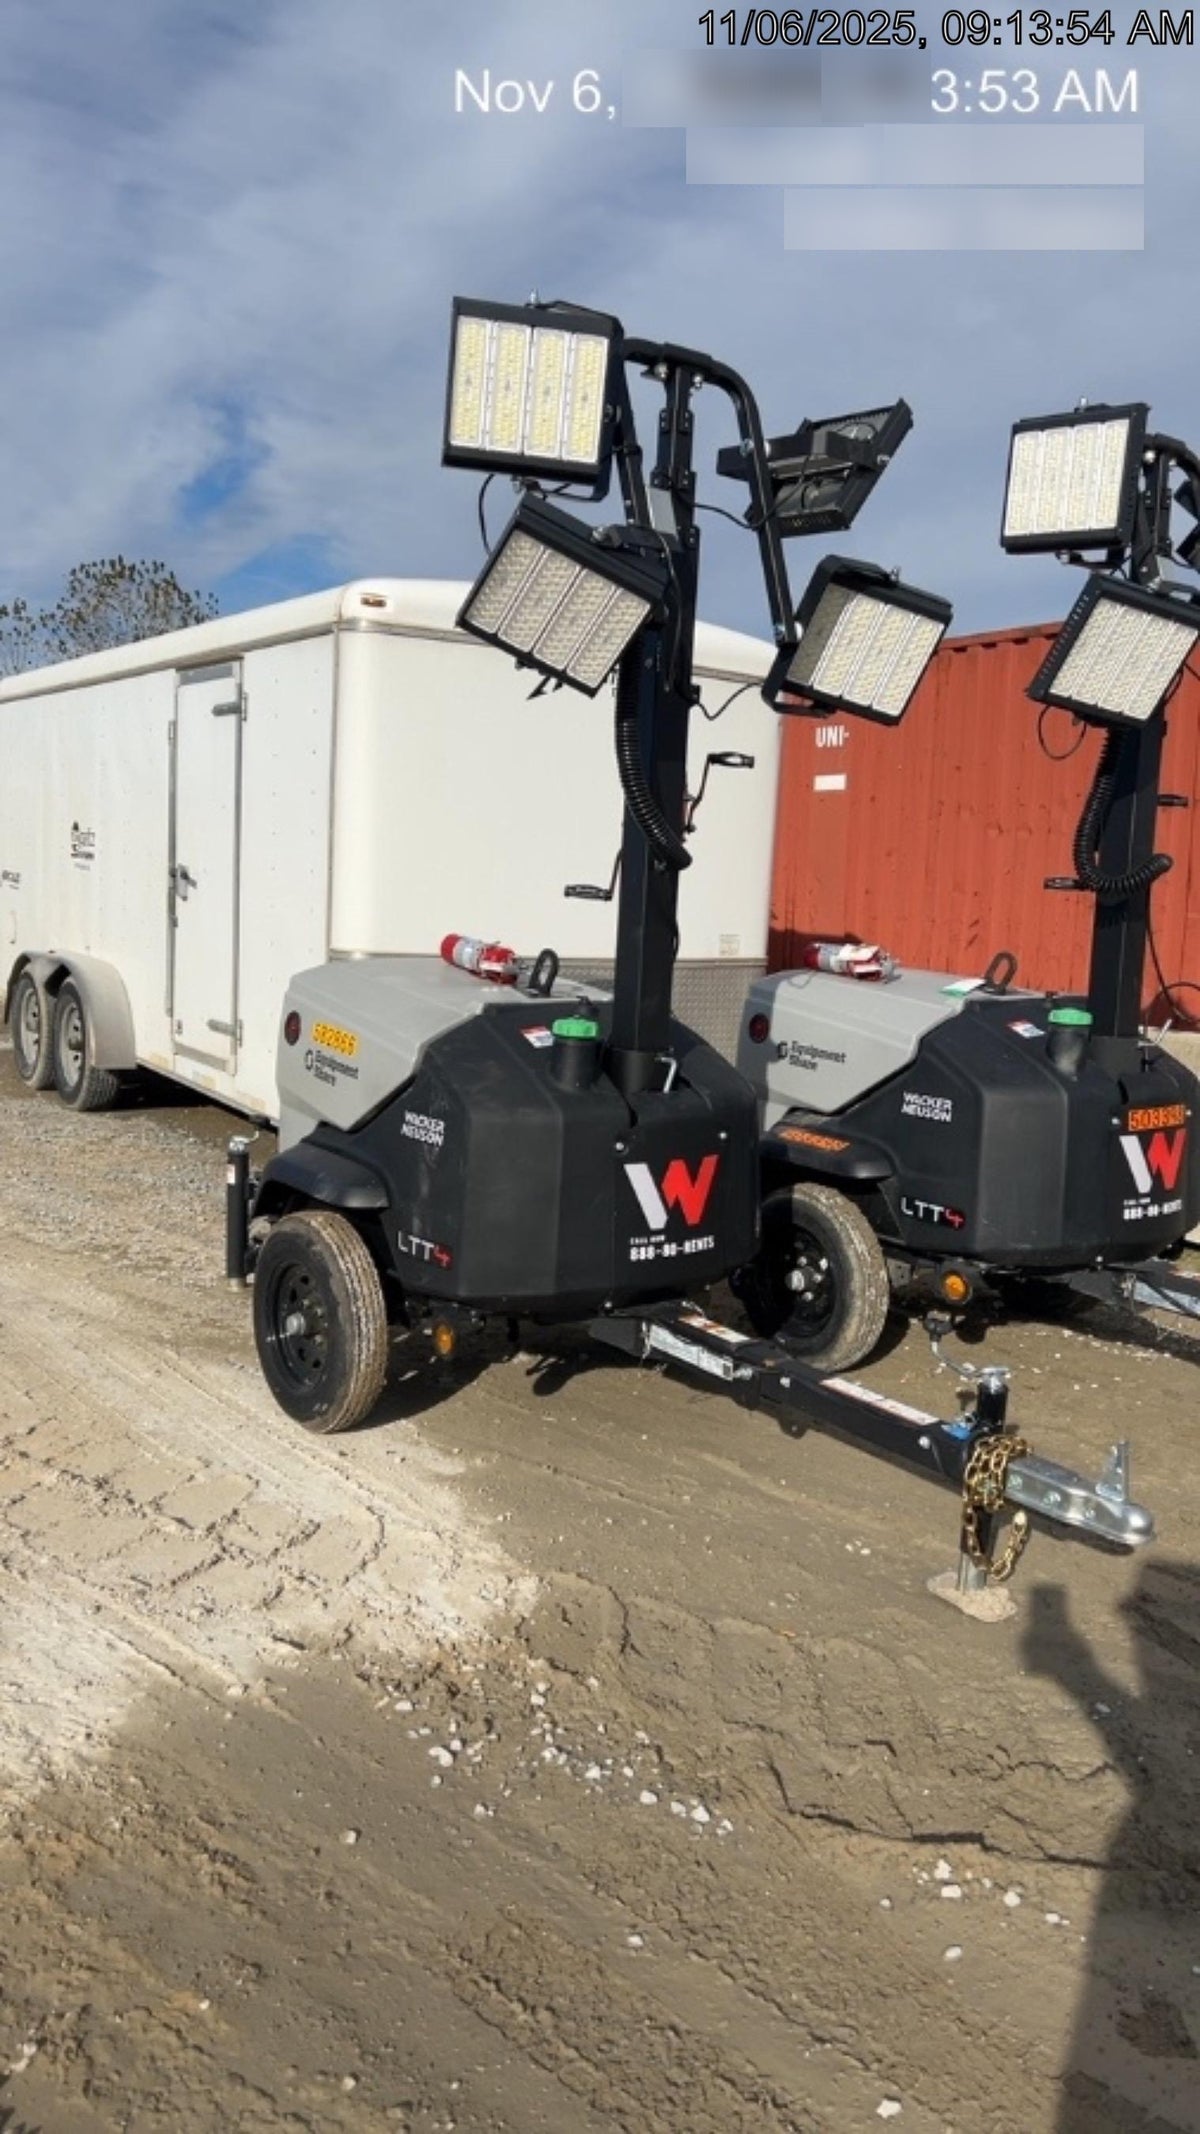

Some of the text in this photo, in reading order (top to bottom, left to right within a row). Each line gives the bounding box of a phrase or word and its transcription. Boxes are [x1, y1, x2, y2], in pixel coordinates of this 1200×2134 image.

[900, 1102, 952, 1123] NEUSON
[902, 1090, 952, 1112] WACKER
[403, 1109, 445, 1134] WACKER
[400, 1122, 445, 1147] NEUSON
[900, 1196, 965, 1229] LTT4
[397, 1230, 451, 1268] LTT4
